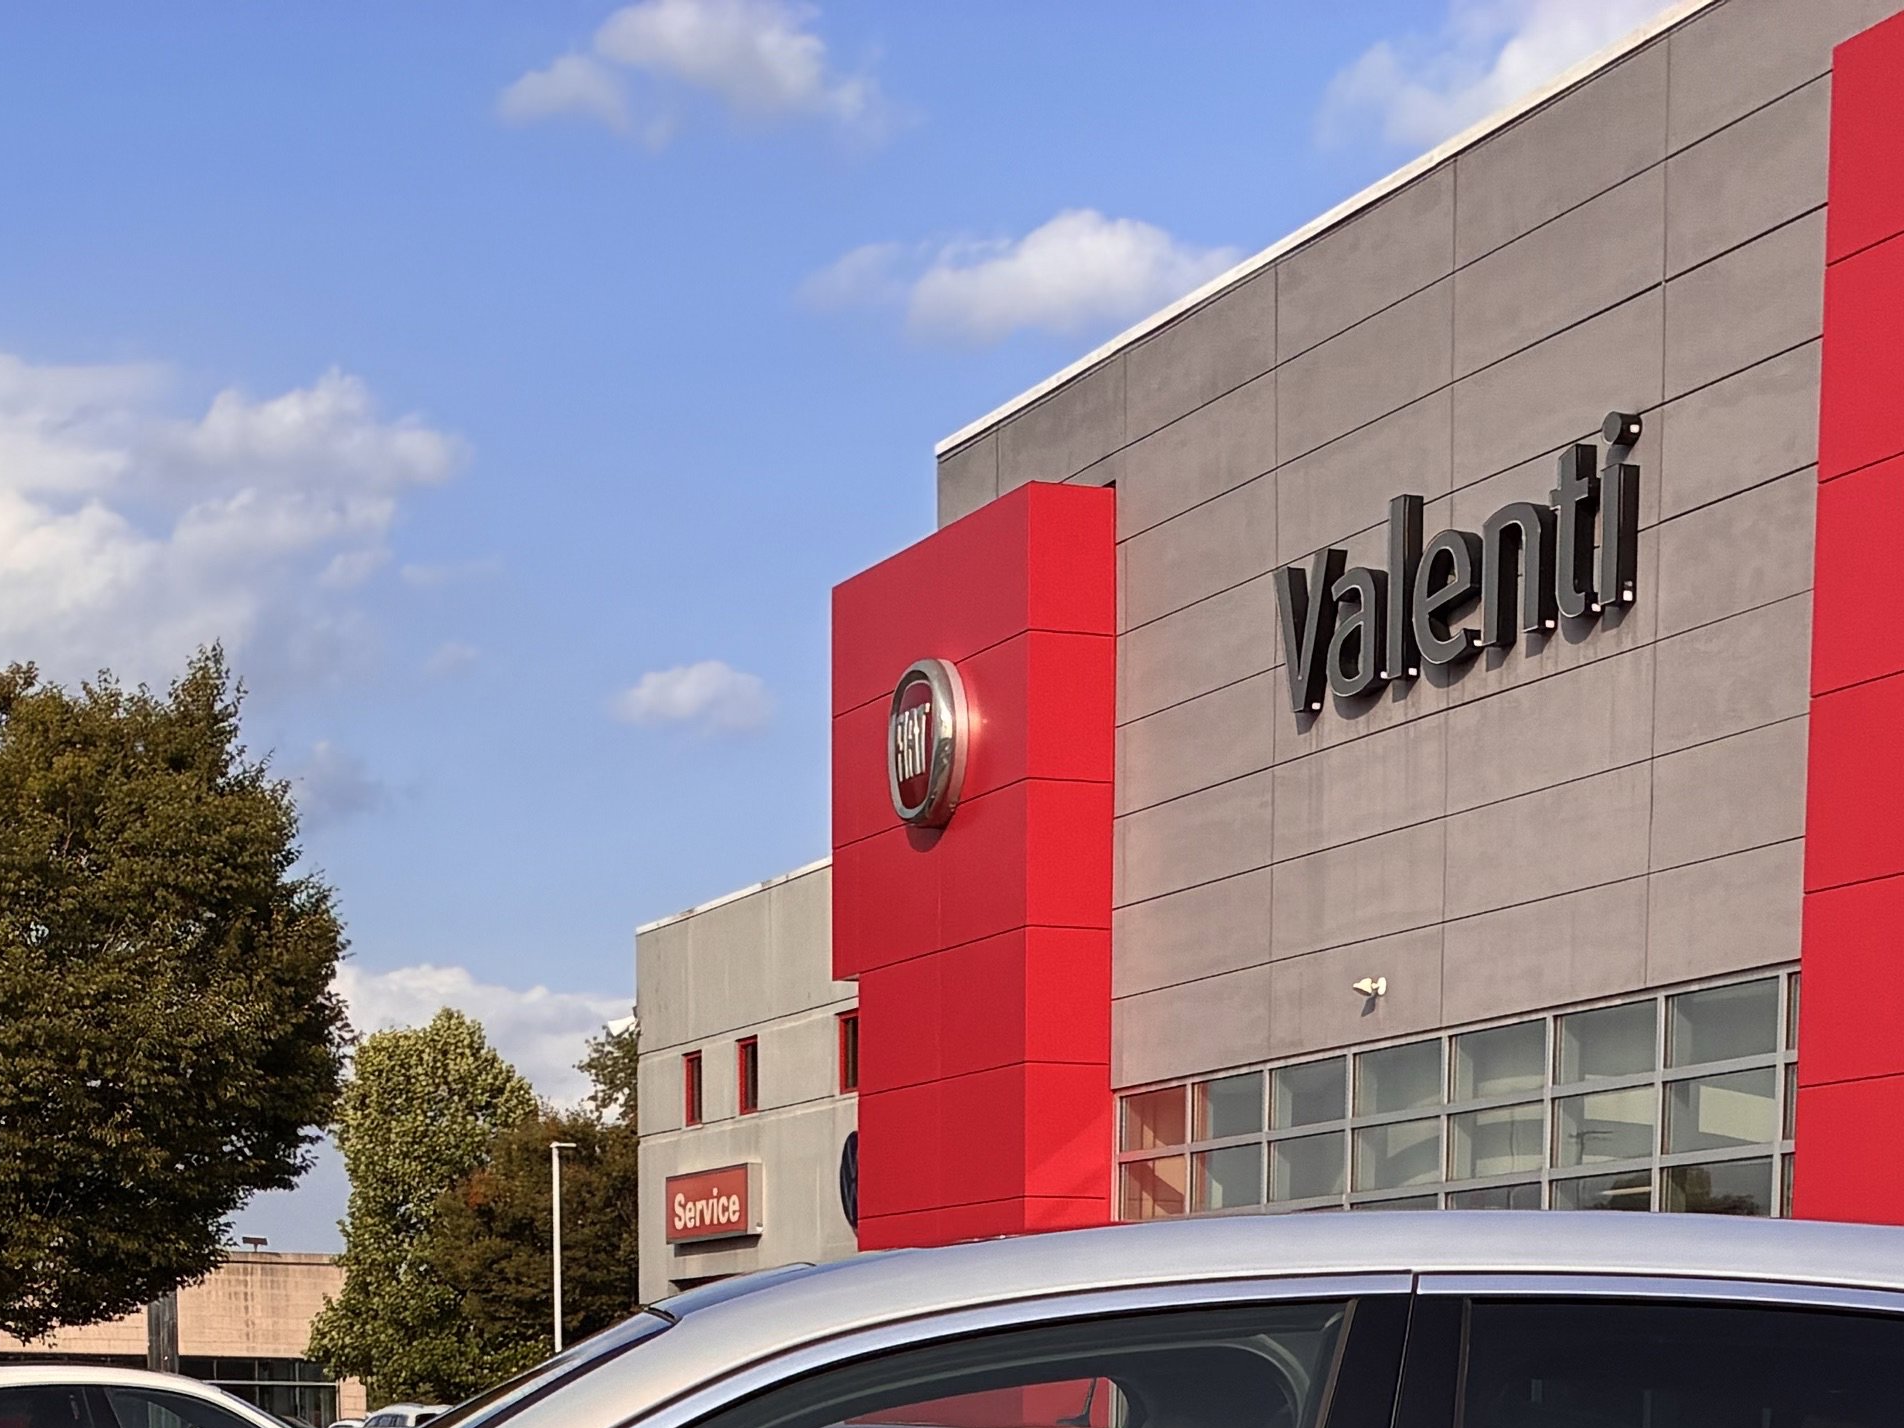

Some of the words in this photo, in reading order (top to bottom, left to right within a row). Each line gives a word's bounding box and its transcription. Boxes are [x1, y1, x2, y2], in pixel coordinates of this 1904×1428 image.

[1273, 411, 1642, 713] Valenti
[897, 702, 932, 783] FIAT
[674, 1187, 741, 1231] Service
